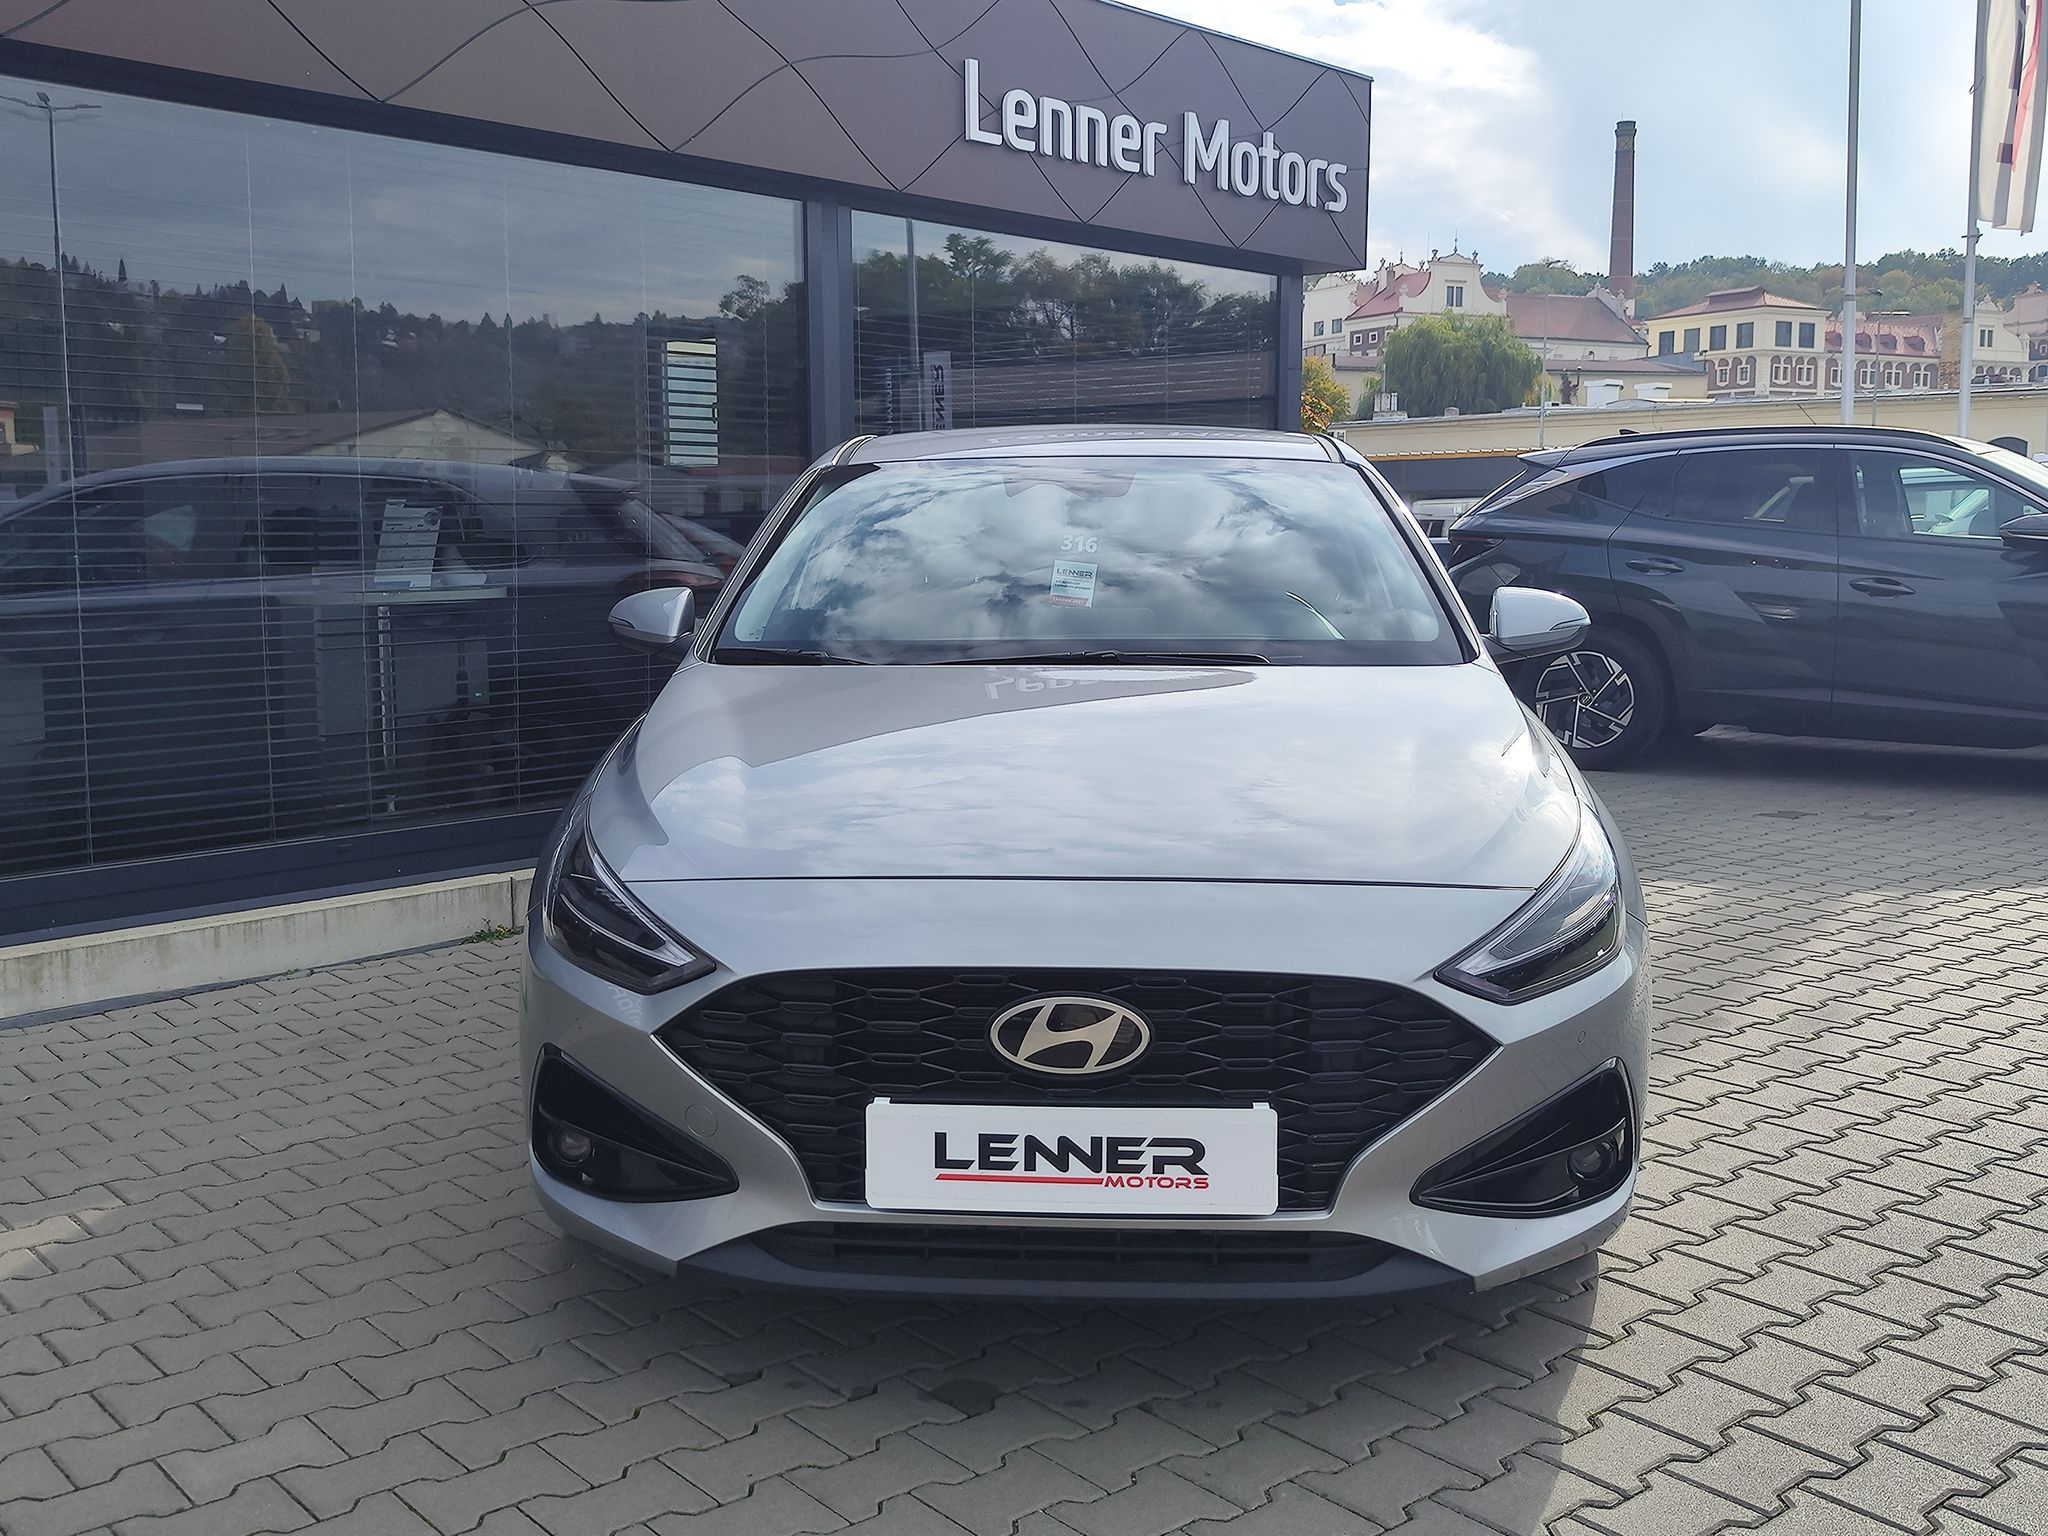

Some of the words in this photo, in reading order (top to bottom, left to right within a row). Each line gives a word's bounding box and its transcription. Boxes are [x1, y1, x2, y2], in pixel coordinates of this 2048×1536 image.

[964, 57, 1168, 177] Lenner
[1183, 111, 1348, 213] Motors
[1060, 534, 1098, 554] 316
[1056, 567, 1093, 580] LENNER
[934, 1131, 1210, 1176] LENNER
[1103, 1175, 1210, 1190] MOTORS
